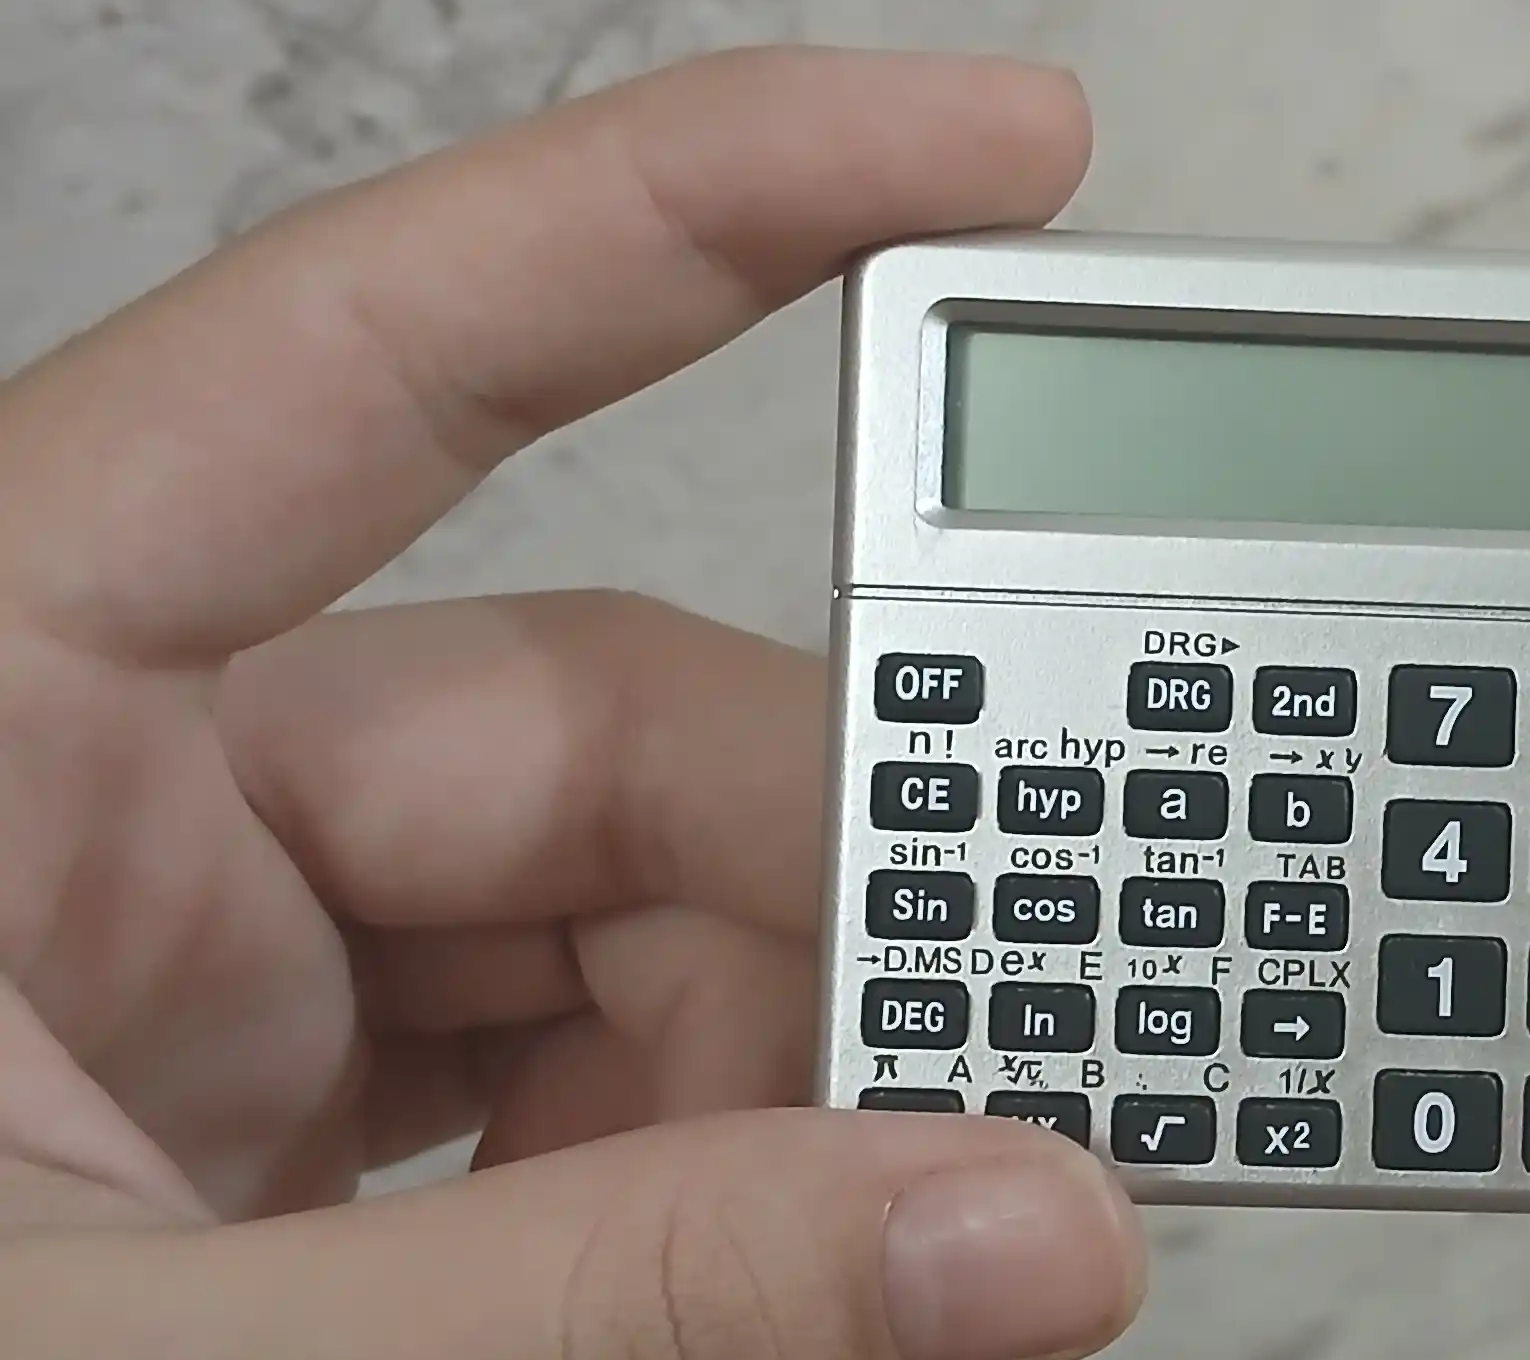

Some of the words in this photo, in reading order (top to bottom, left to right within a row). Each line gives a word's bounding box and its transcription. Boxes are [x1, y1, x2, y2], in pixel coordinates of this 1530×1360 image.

[895, 666, 962, 701] OFF
[1147, 678, 1211, 710] DRG
[1272, 686, 1336, 717] 2nd
[1429, 685, 1473, 746] 7
[995, 736, 1047, 759] arc
[1061, 727, 1125, 768] hyp
[901, 777, 950, 811] CE
[1017, 780, 1081, 819] hyp
[1160, 789, 1187, 820] a
[1287, 794, 1311, 827] b
[1277, 854, 1346, 880] TAB
[1422, 821, 1468, 883] 4
[892, 889, 947, 922] Sin
[1013, 895, 1076, 923] cos
[1142, 897, 1197, 929] tan
[1263, 903, 1327, 934] F-E
[1258, 959, 1350, 988] CPLX
[1427, 957, 1453, 1017] 1
[881, 1000, 945, 1033] DEG
[1139, 1002, 1193, 1045] log
[1414, 1091, 1456, 1153] 0
